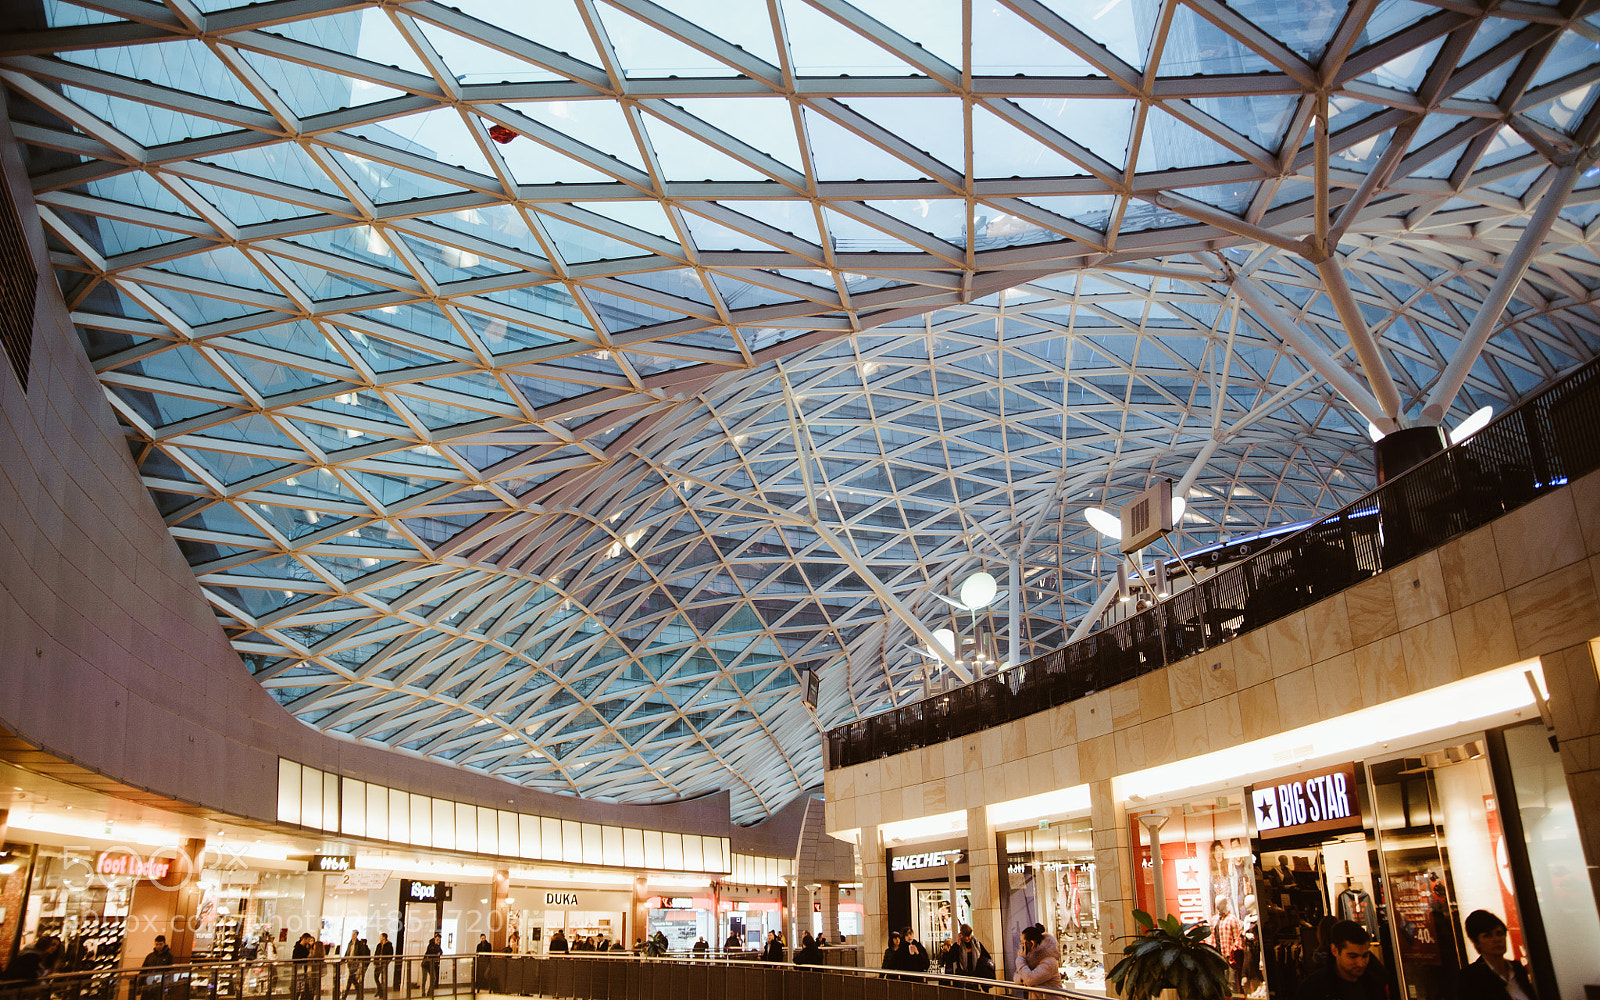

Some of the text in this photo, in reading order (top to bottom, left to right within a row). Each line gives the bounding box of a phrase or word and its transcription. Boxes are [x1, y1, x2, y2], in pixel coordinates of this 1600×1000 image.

[1278, 772, 1351, 827] BIG STAR
[97, 852, 170, 878] Foot Locker
[891, 849, 962, 871] SKECHERS
[343, 874, 350, 885] 2
[411, 881, 436, 900] iSpot
[546, 892, 579, 906] DUKA
